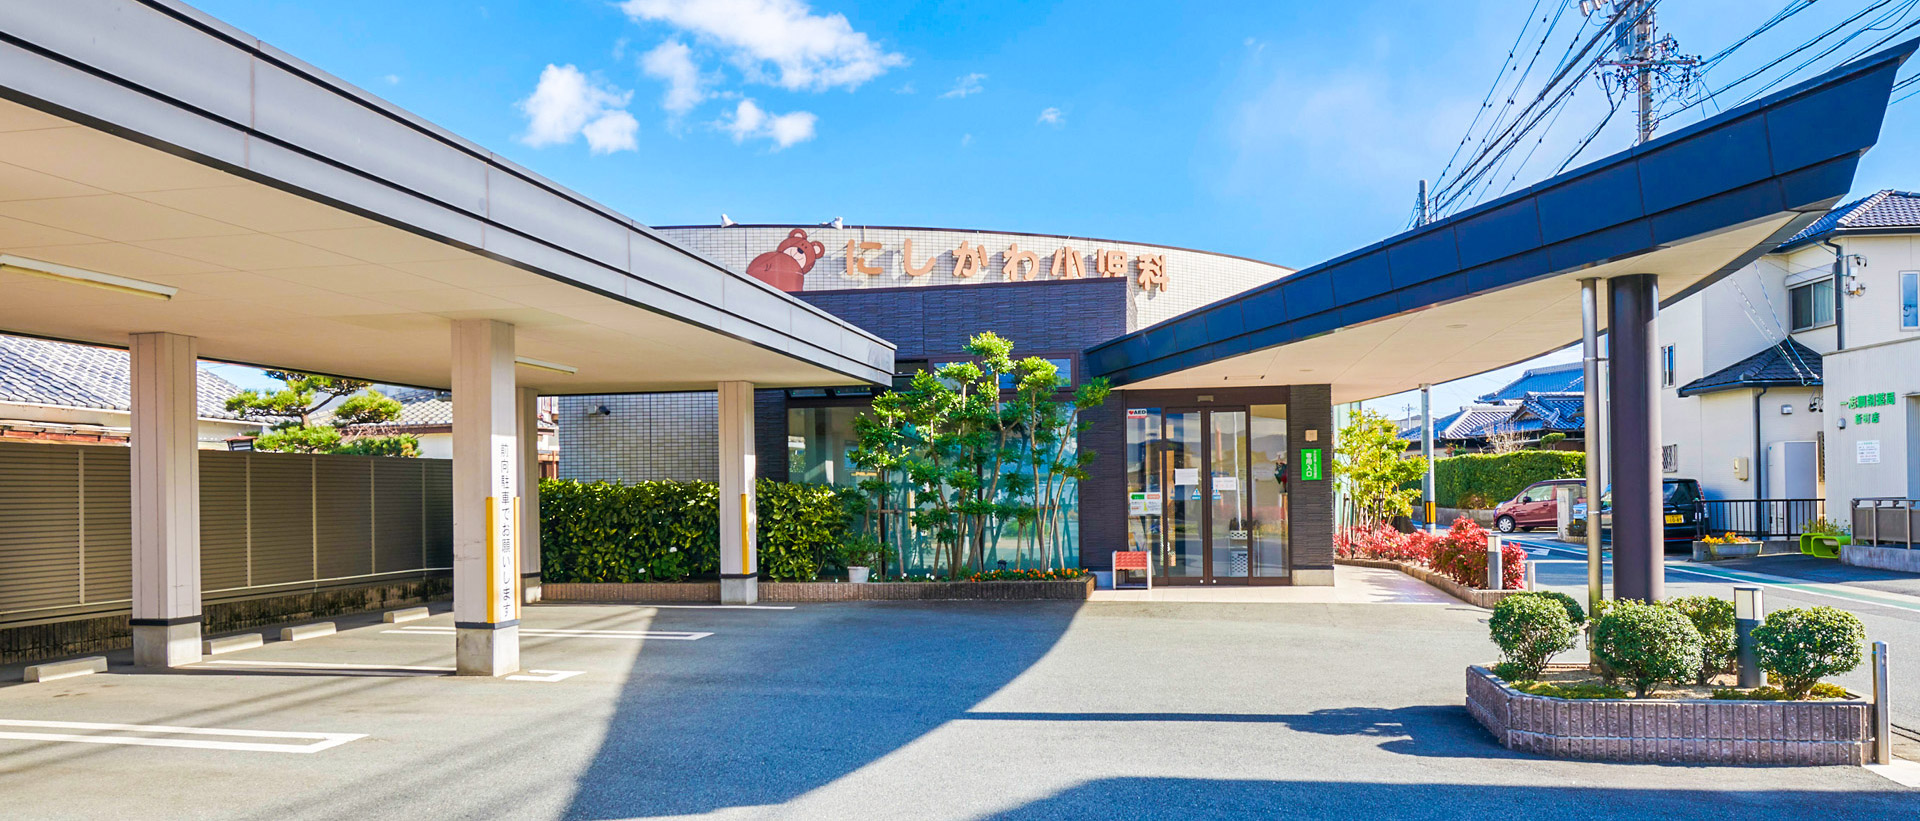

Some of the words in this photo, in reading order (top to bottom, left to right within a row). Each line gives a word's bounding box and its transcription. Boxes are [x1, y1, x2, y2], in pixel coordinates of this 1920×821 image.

[846, 238, 1171, 293] にしかわ小児科
[500, 443, 511, 618] 前向駐車でお願いします
